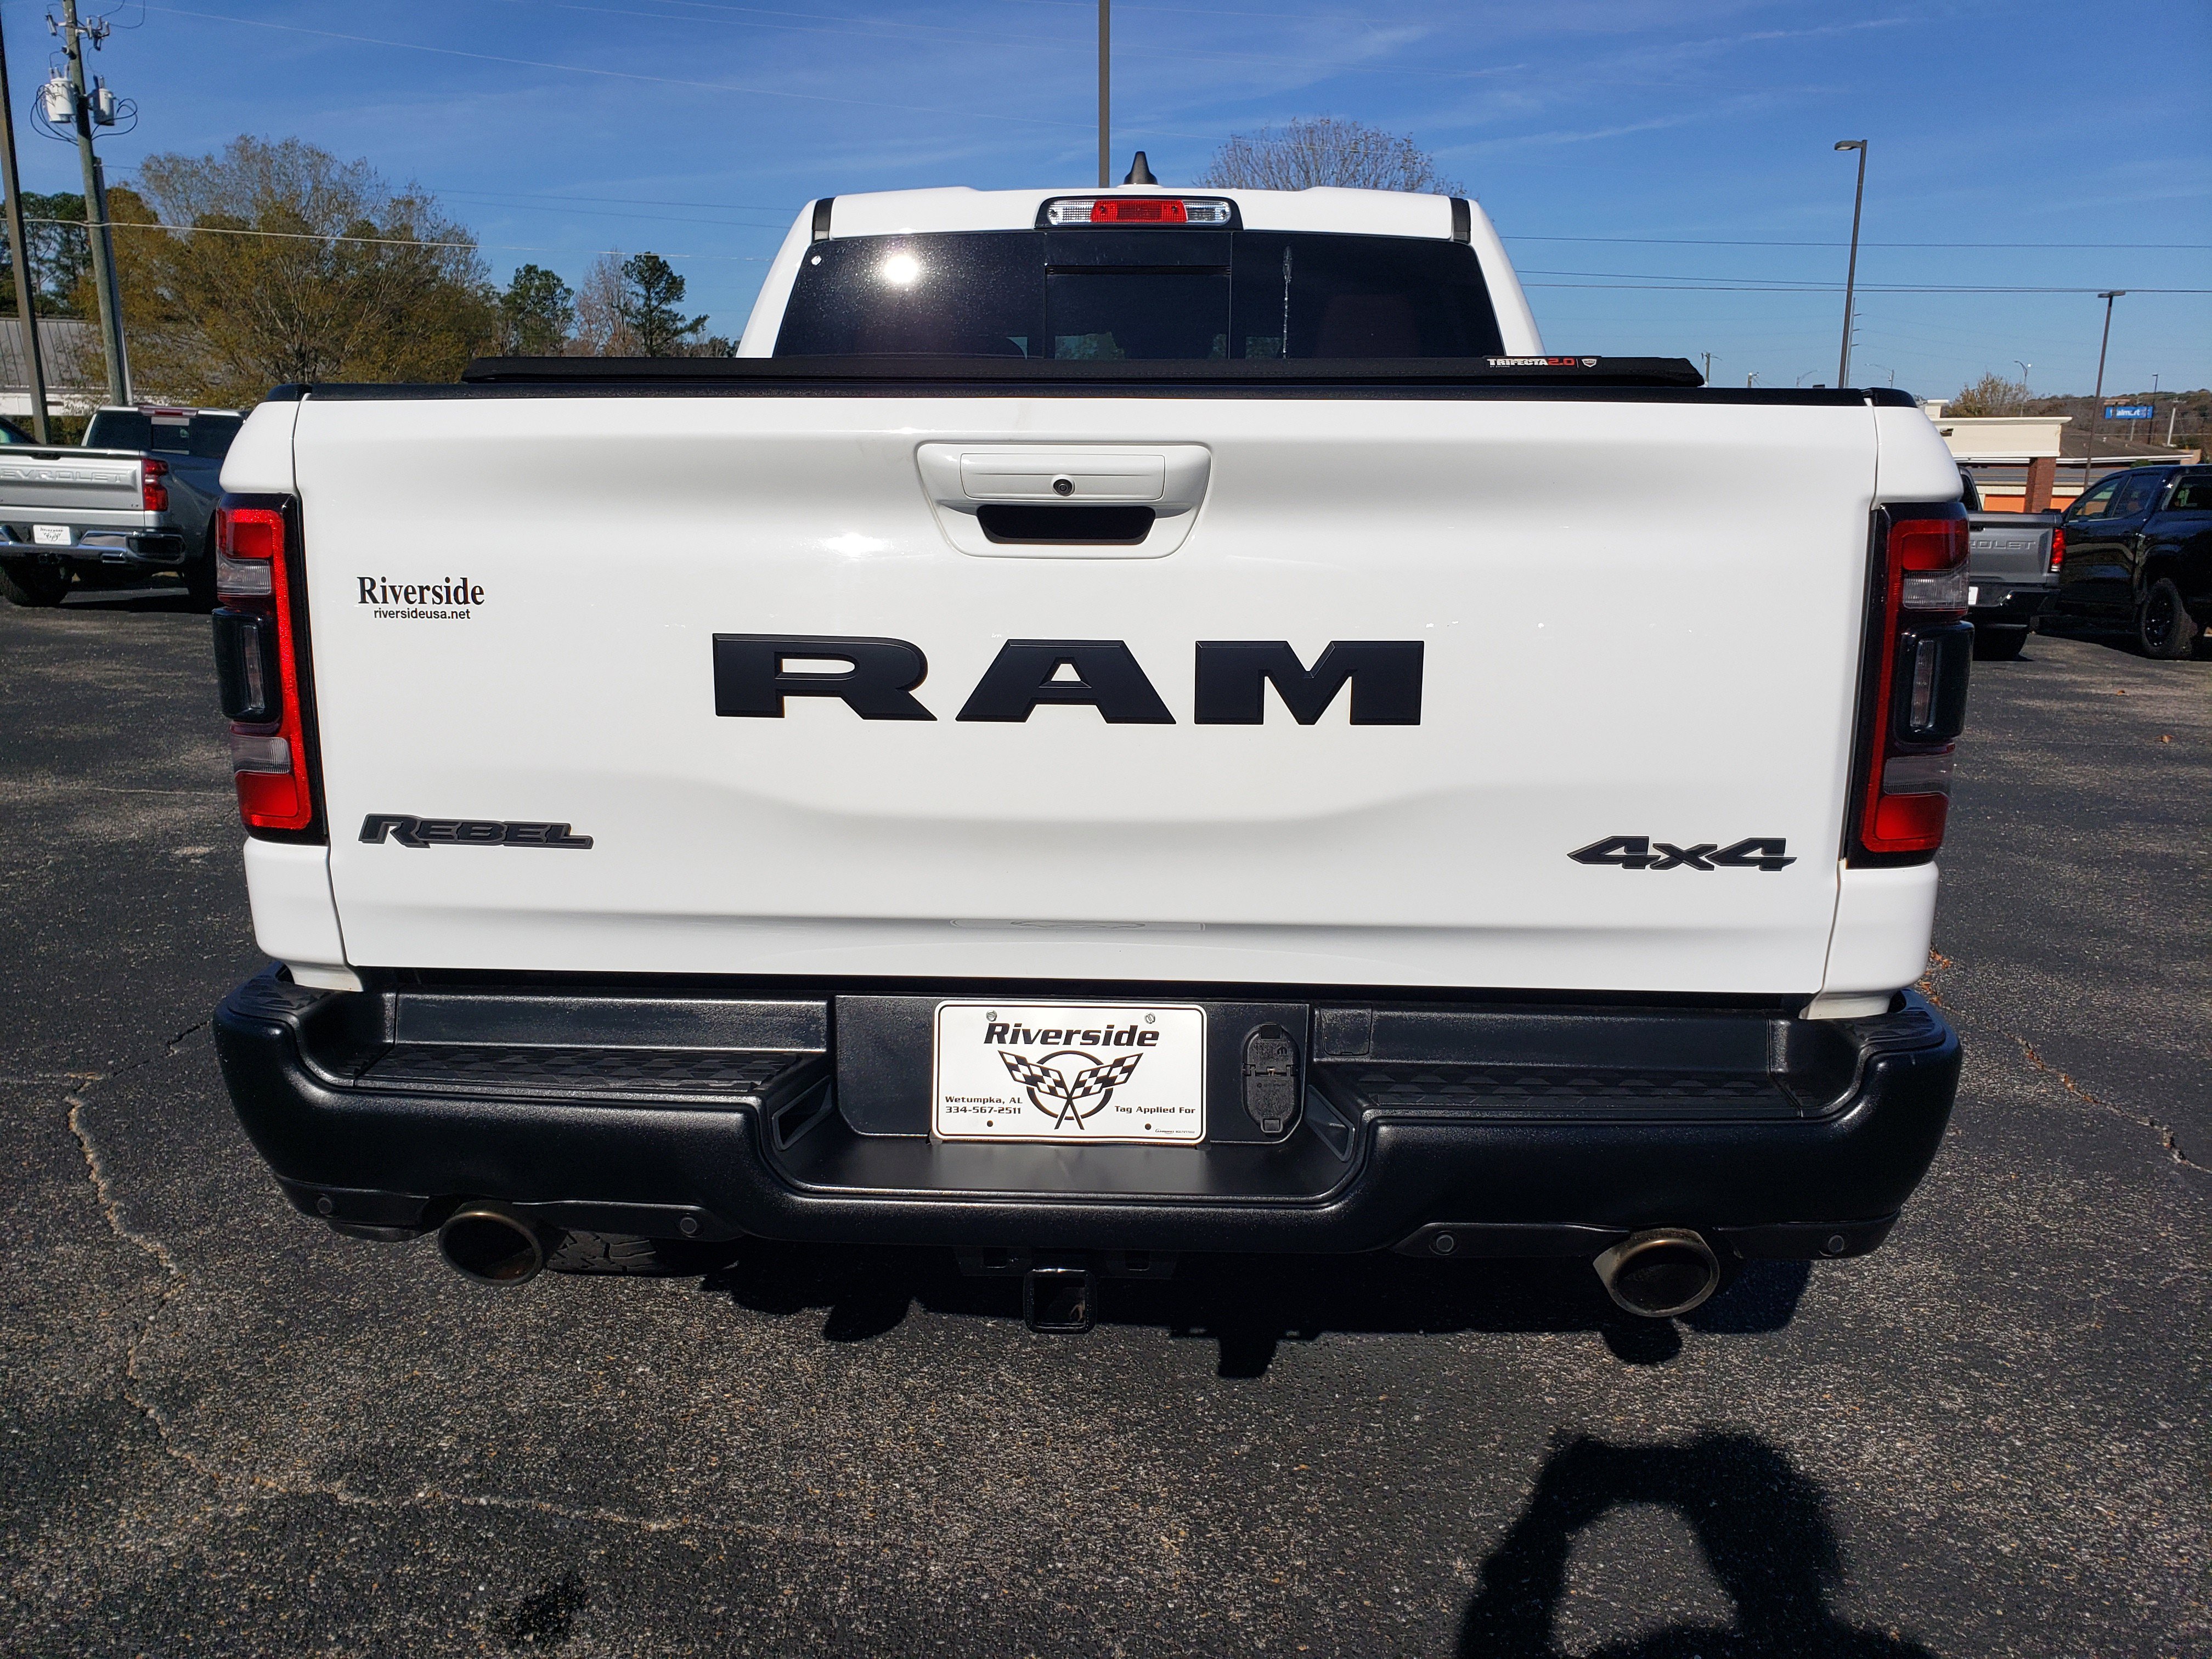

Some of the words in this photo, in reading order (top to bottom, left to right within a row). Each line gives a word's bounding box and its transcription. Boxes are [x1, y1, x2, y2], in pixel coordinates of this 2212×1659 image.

[357, 576, 485, 605] Riverside
[374, 607, 471, 619] riversideusa.net
[713, 633, 1424, 725] RAM
[358, 814, 594, 849] REBEL
[1567, 836, 1798, 871] 4x4
[984, 1023, 1160, 1047] Riverside
[945, 1096, 1005, 1105] Wetumpka,
[945, 1106, 1021, 1114] 334-567-2511
[1114, 1105, 1132, 1114] Tag
[1136, 1106, 1175, 1114] Applied
